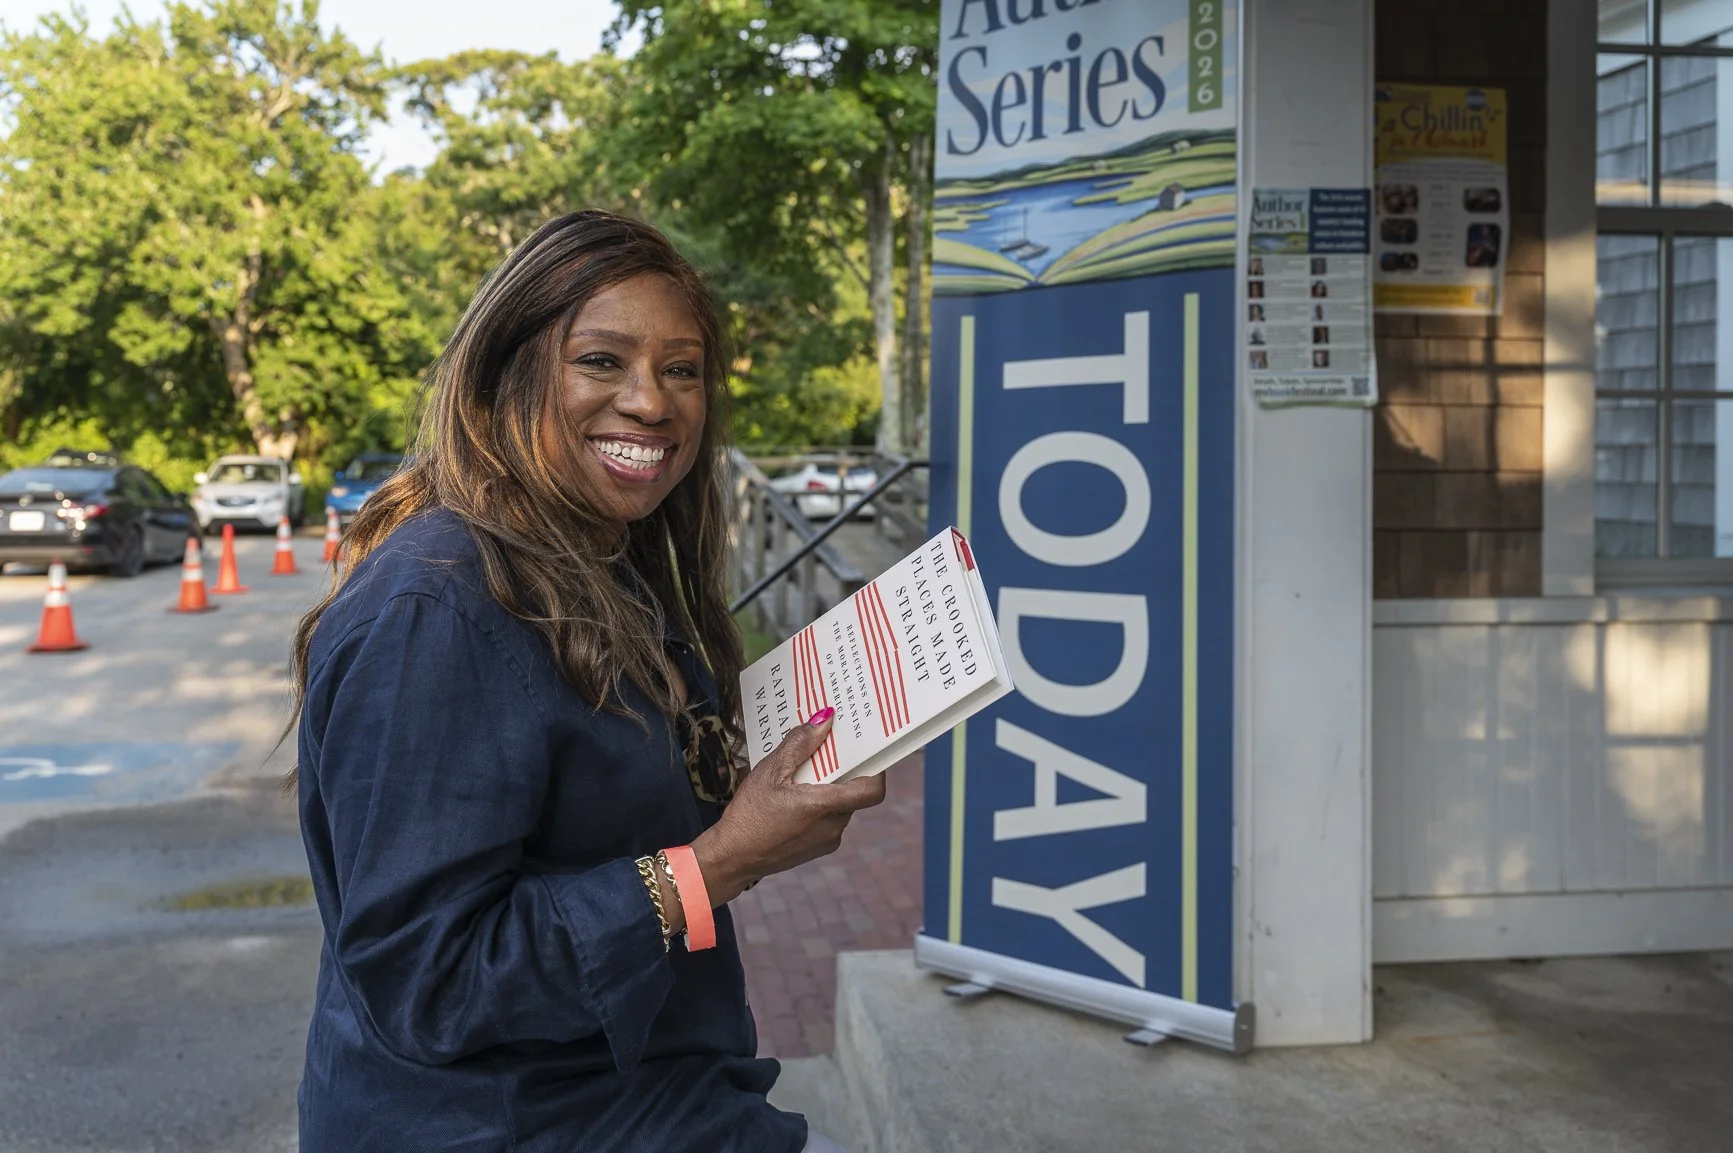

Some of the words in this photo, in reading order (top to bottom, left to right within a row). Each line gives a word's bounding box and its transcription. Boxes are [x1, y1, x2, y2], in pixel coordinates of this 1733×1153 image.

[947, 32, 1166, 156] Series
[1194, 4, 1218, 105] 2026
[826, 653, 834, 666] OF
[895, 585, 930, 683] STRAIGHT
[911, 555, 937, 625] PLACES
[930, 631, 957, 690] MADE
[930, 541, 948, 578] THE
[941, 584, 977, 676] CROOKED
[992, 311, 1151, 989] TODAY
[829, 671, 844, 721] AMERICA
[832, 620, 842, 642] THE
[837, 645, 850, 683] MORAL
[846, 685, 862, 739] MEANING
[846, 624, 868, 698] REFLECTIONS
[863, 702, 872, 718] ON
